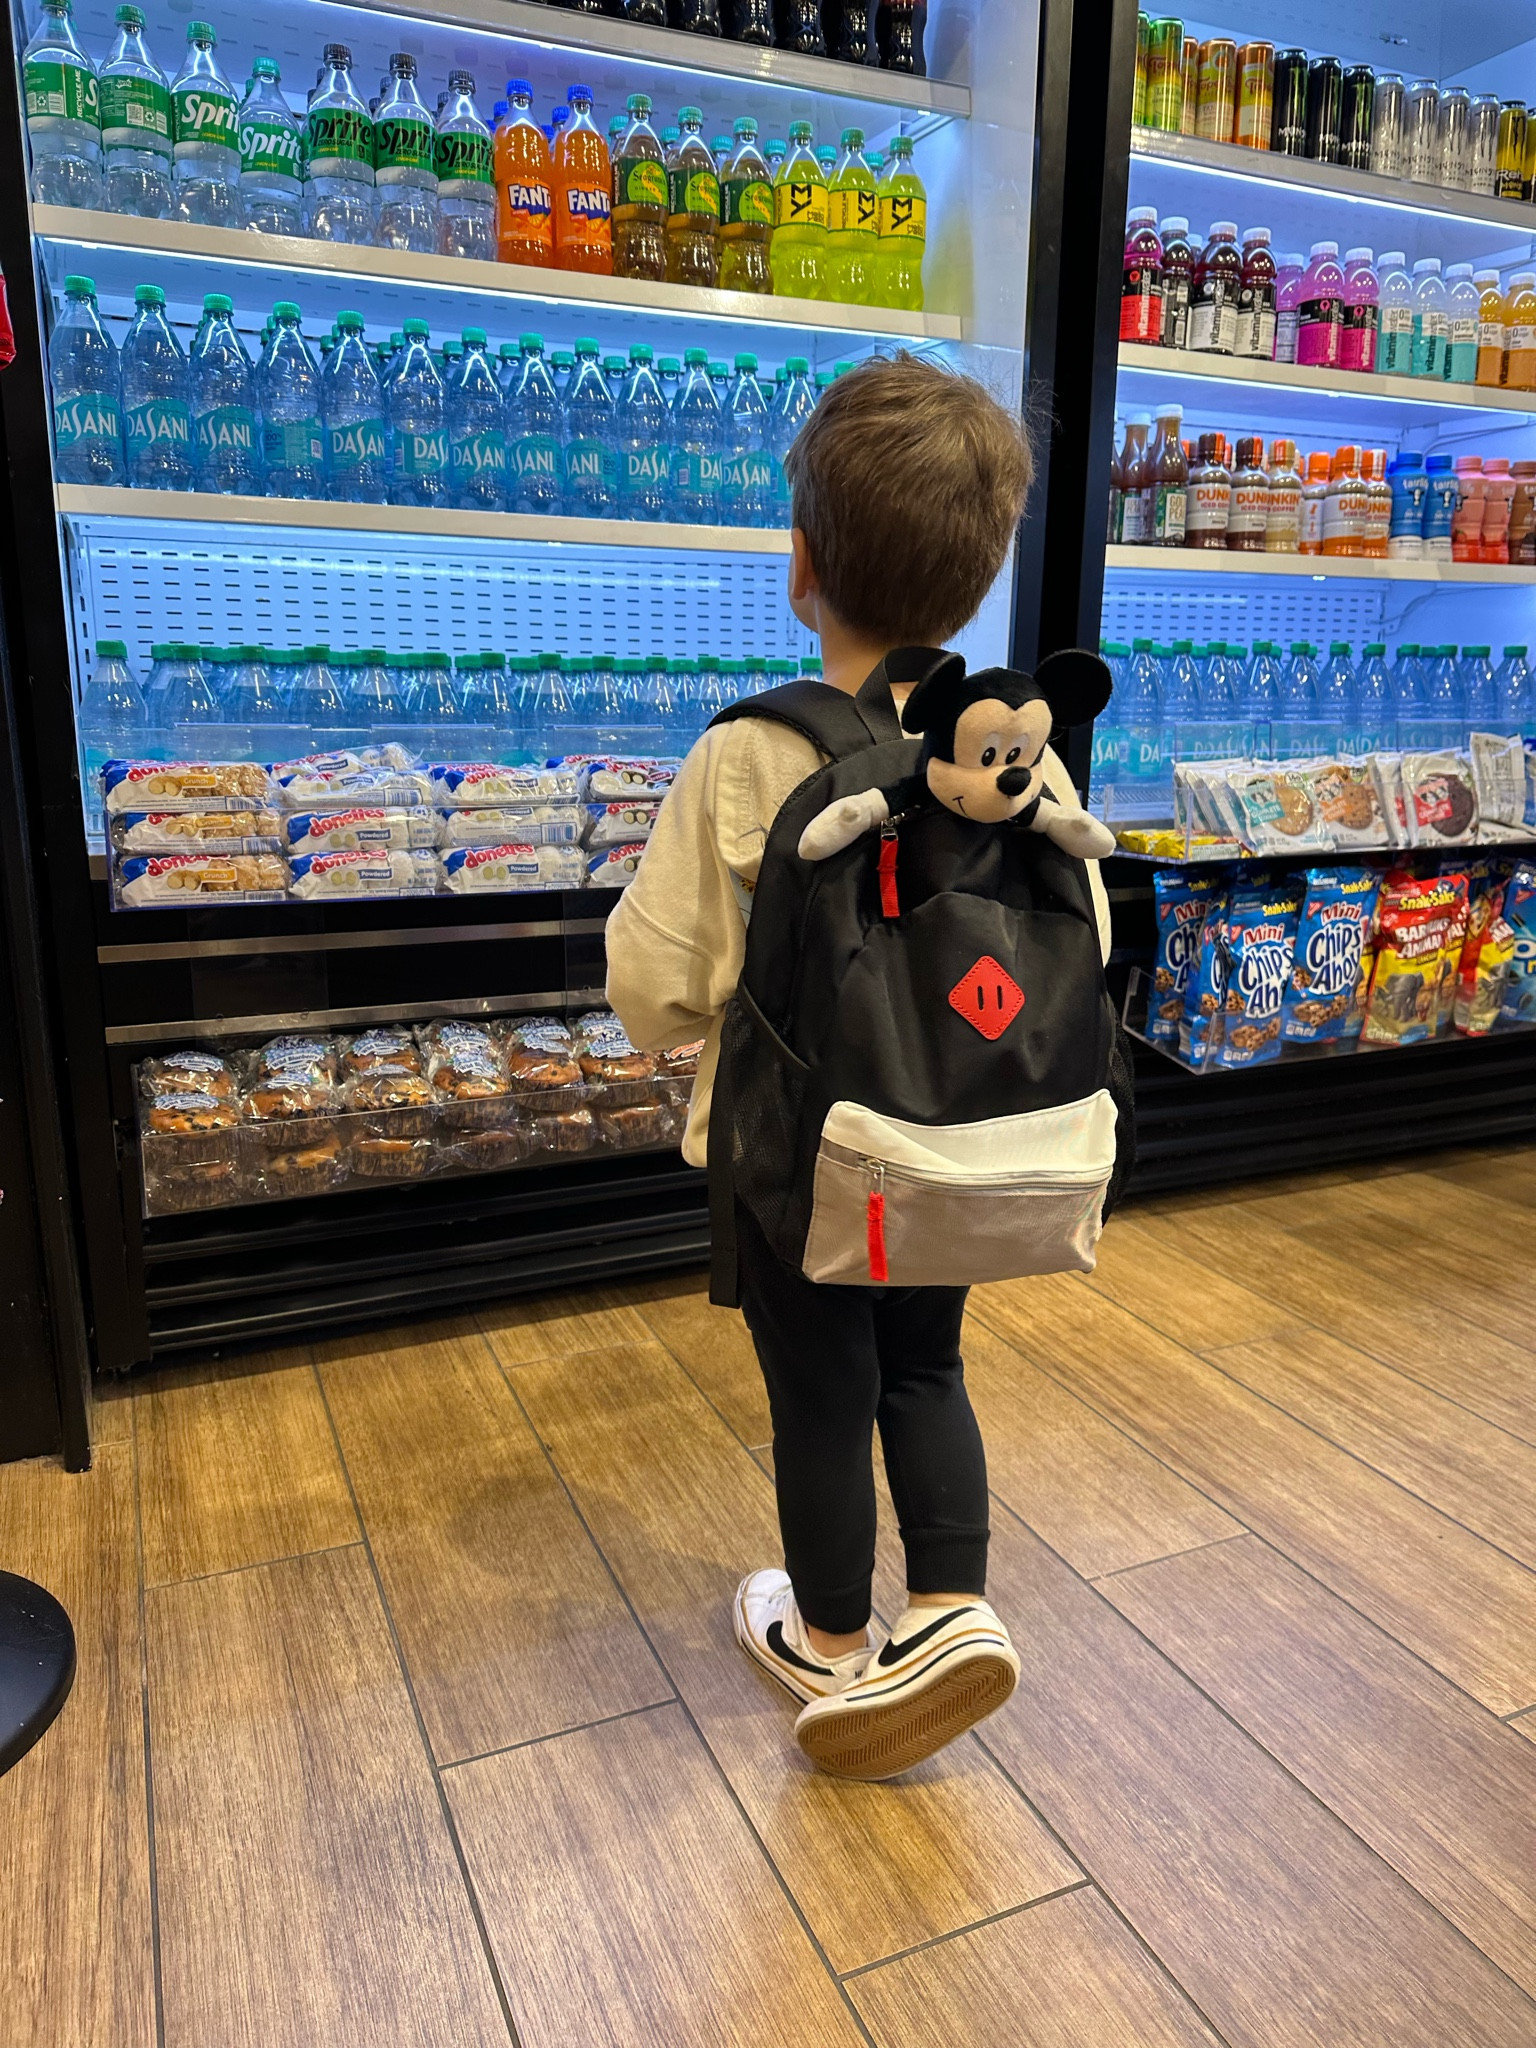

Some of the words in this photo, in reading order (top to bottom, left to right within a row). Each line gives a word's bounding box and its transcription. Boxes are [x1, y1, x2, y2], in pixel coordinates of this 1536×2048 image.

[181, 94, 240, 133] Sprit
[308, 111, 371, 148] Sprite
[1210, 279, 1225, 345] vitaminwater
[1250, 288, 1264, 352] vitaminwater
[1169, 507, 1187, 521] PEA
[184, 777, 209, 785] Crunch
[309, 808, 385, 837] donettes
[359, 831, 389, 840] Powdered
[465, 843, 534, 869] donettes
[361, 870, 391, 878] Powdered
[1321, 901, 1362, 926] Mini
[1243, 923, 1285, 946] Mini
[1307, 923, 1363, 973] Chips
[1239, 945, 1295, 995] Chips
